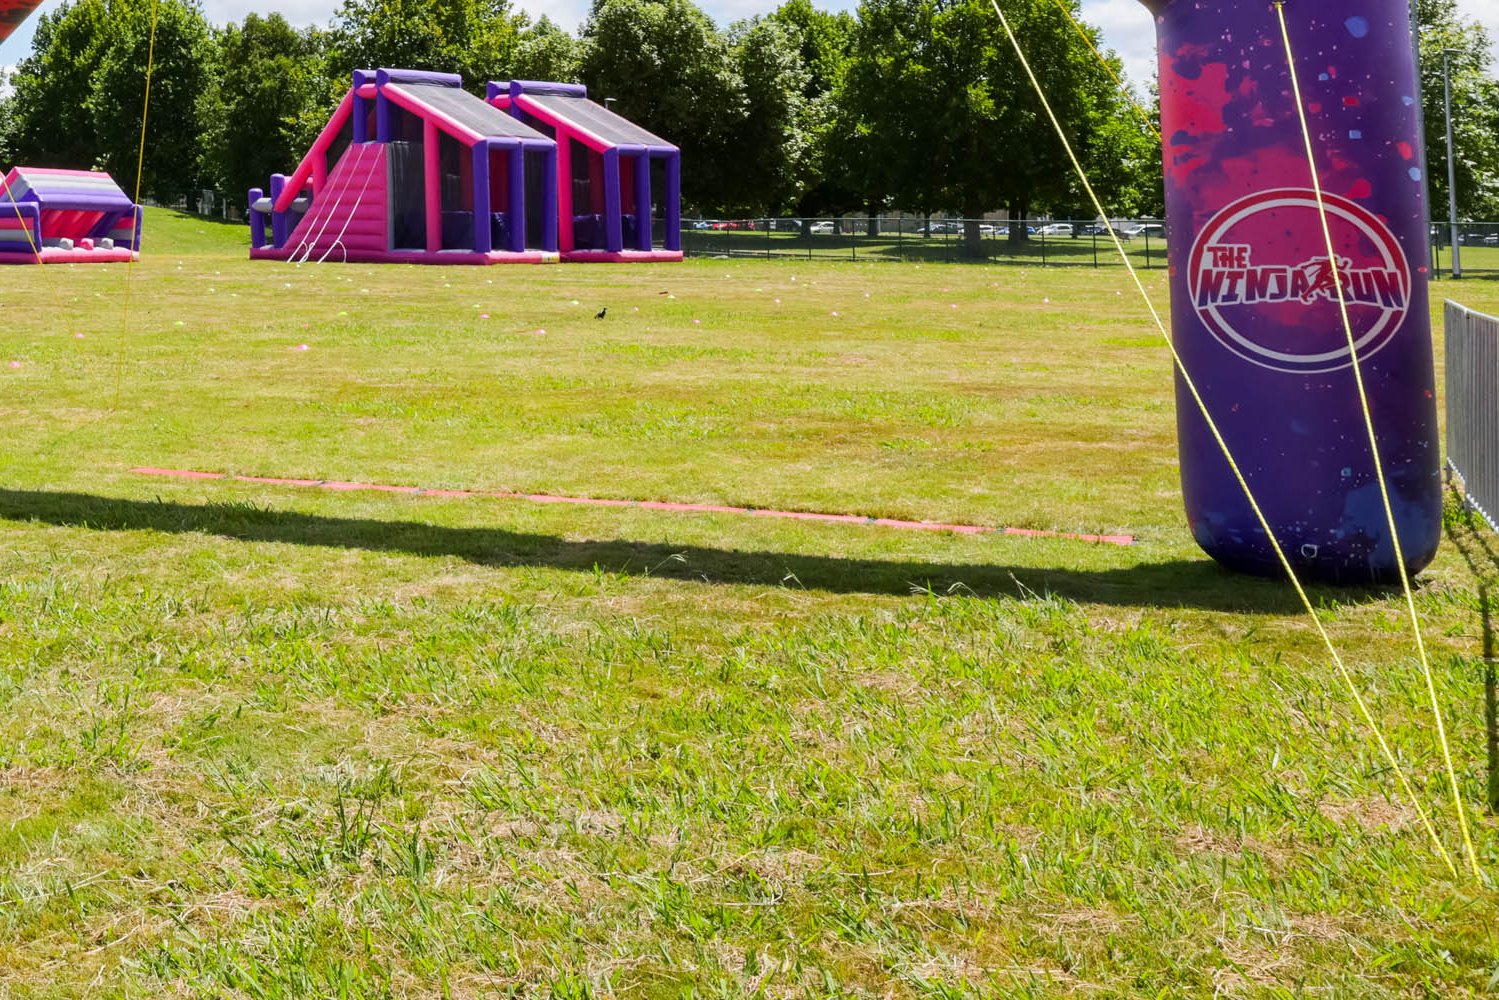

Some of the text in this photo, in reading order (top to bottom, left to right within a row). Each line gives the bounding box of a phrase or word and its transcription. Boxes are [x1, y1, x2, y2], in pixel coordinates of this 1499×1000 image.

[1205, 245, 1249, 268] THE
[1197, 267, 1405, 308] NINJA RUN
